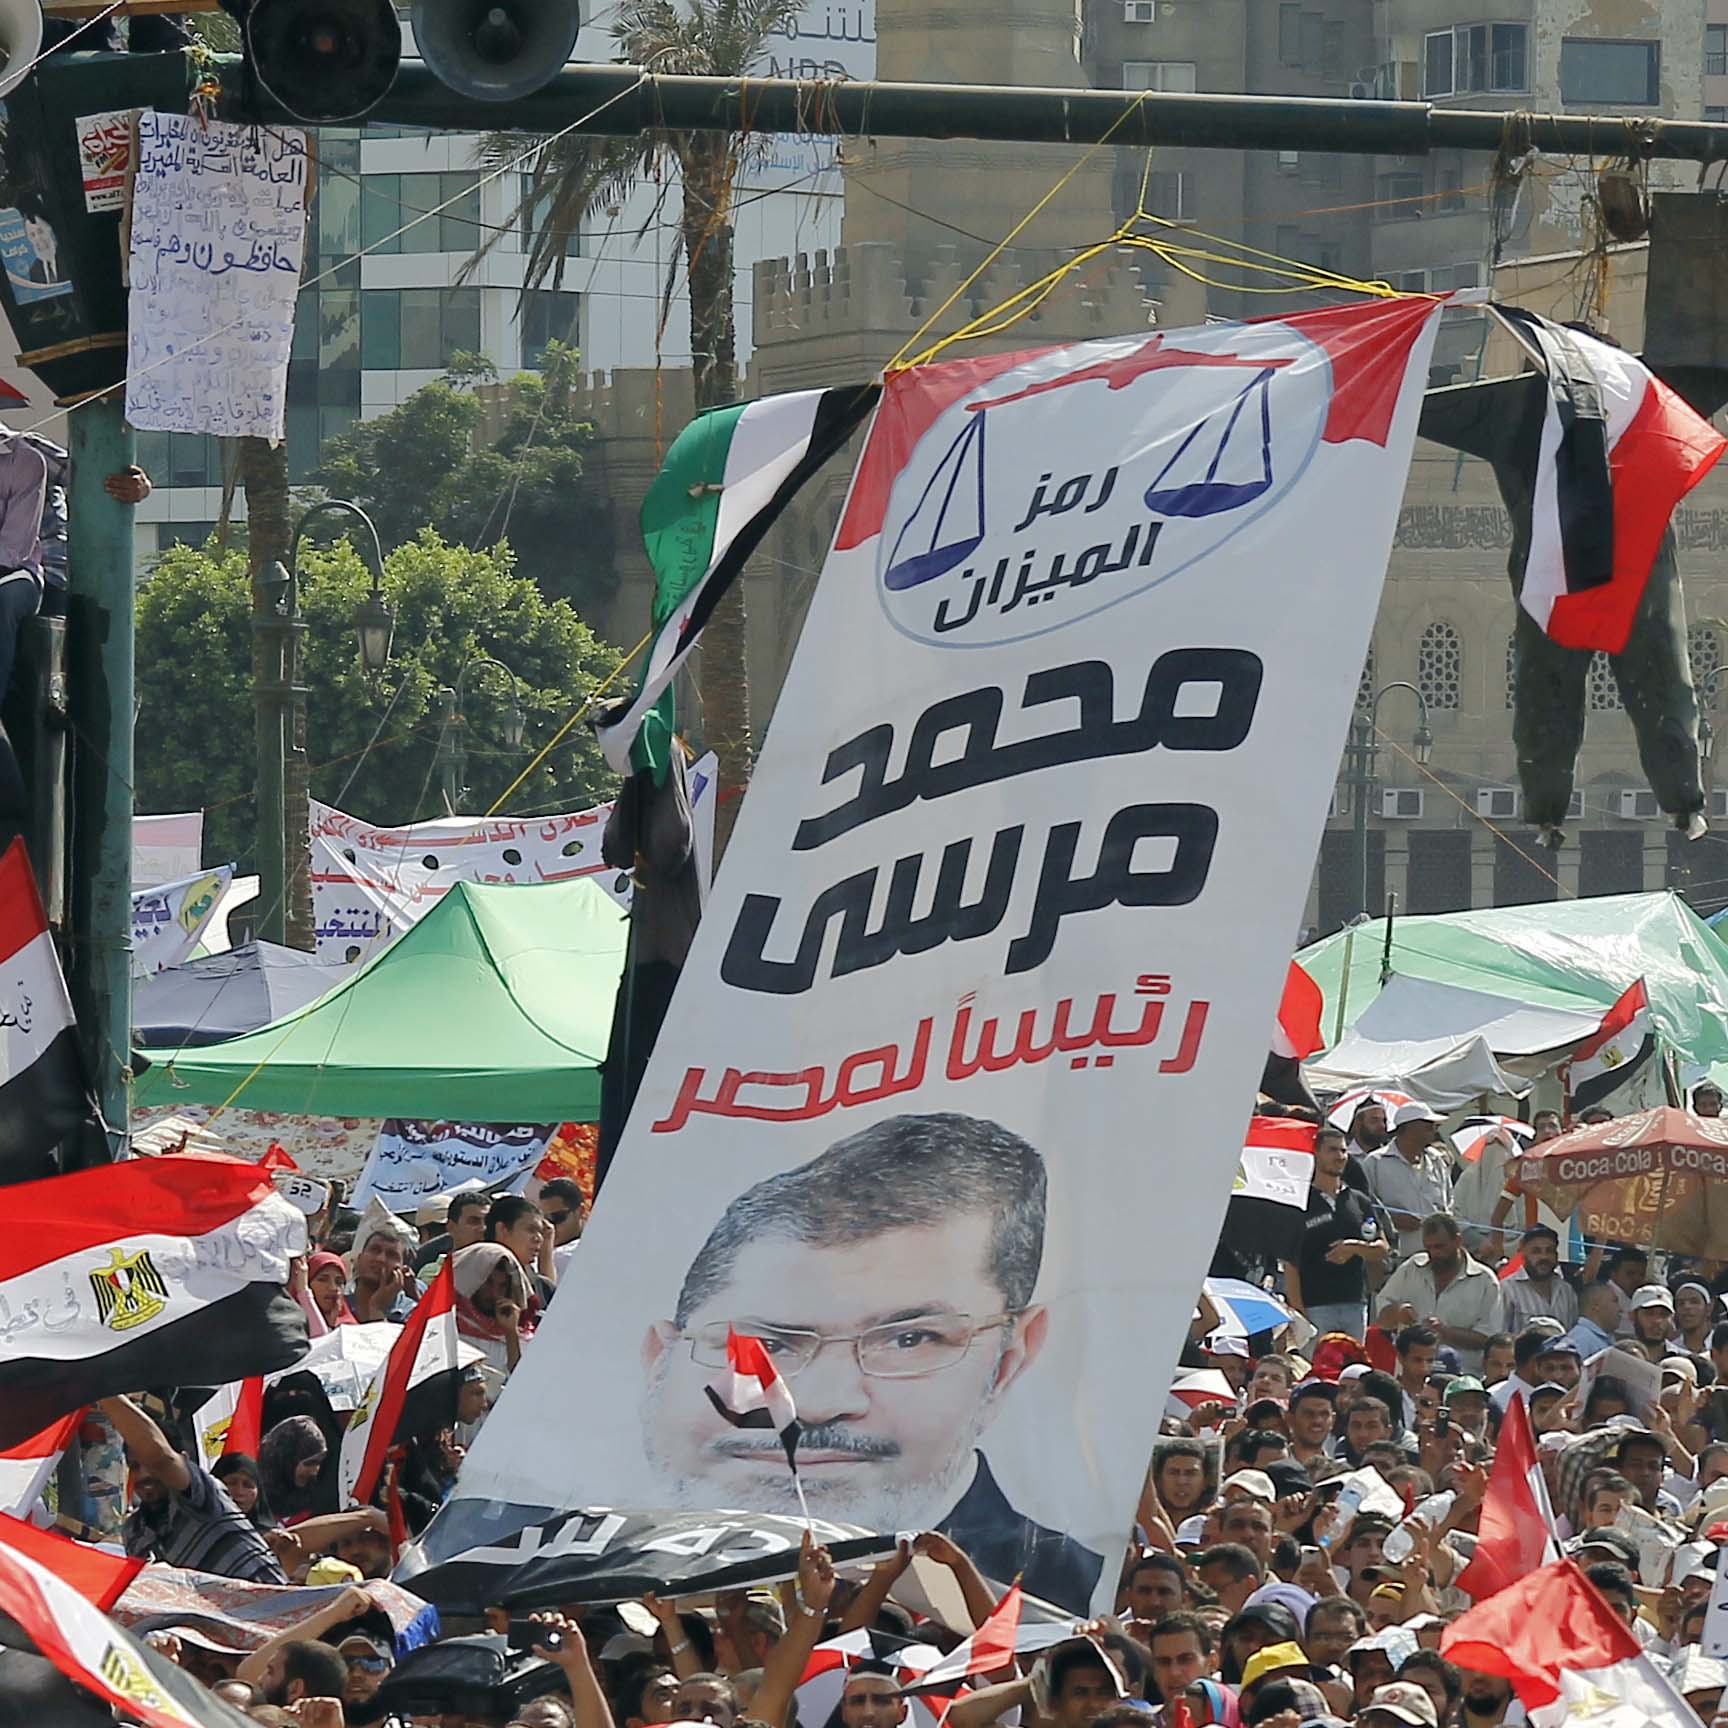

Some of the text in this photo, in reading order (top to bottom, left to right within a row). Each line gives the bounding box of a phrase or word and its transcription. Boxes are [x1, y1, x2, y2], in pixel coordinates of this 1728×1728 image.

[1012, 466, 1114, 532] رمز
[933, 519, 1163, 634] الميزان
[791, 646, 1265, 852] محمد
[719, 801, 1219, 995] مرسى
[652, 1013, 934, 1134] لمصر
[1558, 1148, 1653, 1182] Coca-Cola
